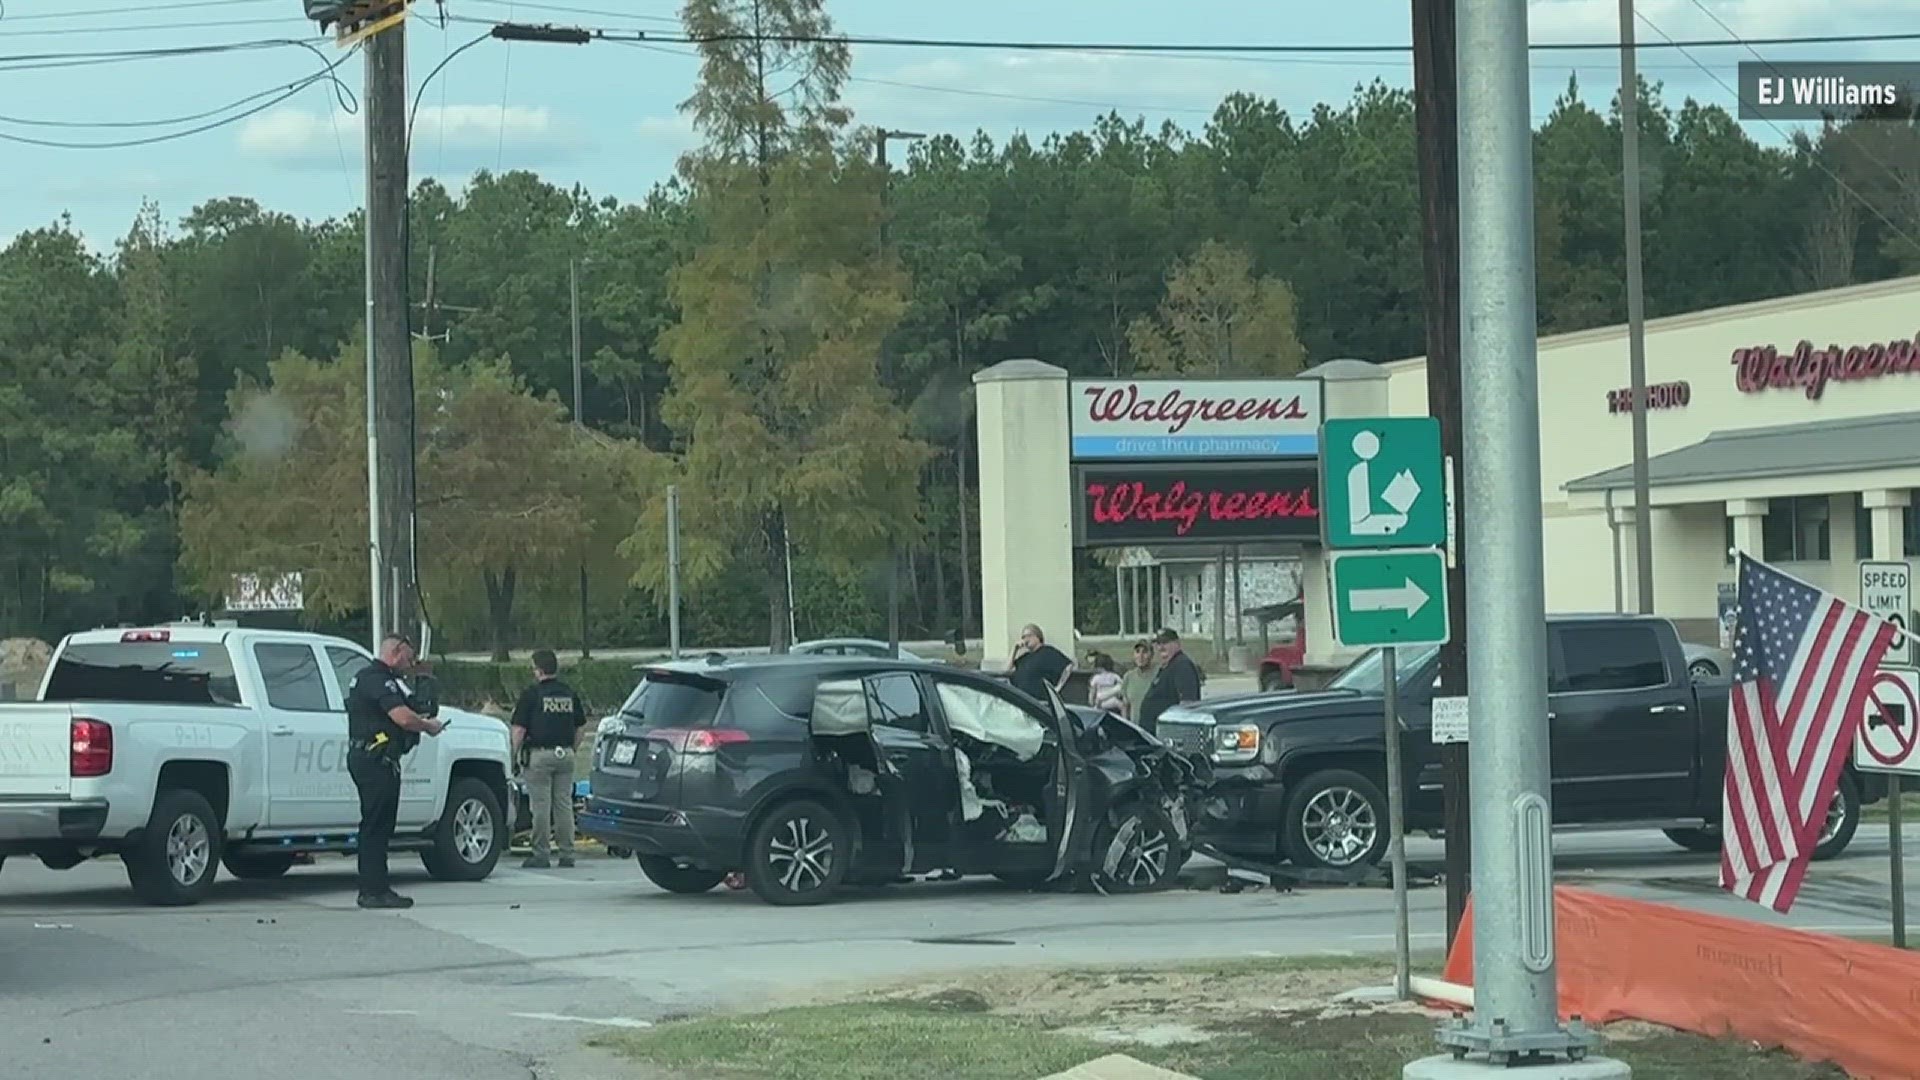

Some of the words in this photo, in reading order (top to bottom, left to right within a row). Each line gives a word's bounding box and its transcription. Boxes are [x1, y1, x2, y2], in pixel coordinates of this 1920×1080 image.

[1645, 381, 1691, 409] HOTO
[1084, 383, 1308, 434] Walgreens
[1116, 437, 1158, 453] drive
[1161, 437, 1195, 453] thru
[1201, 436, 1281, 455] pharmacy
[1087, 480, 1320, 537] Walgreens
[1864, 571, 1907, 588] SPEED
[1868, 595, 1901, 610] LIMIT
[543, 701, 574, 713] POLICE
[175, 725, 213, 745] 9-1-1
